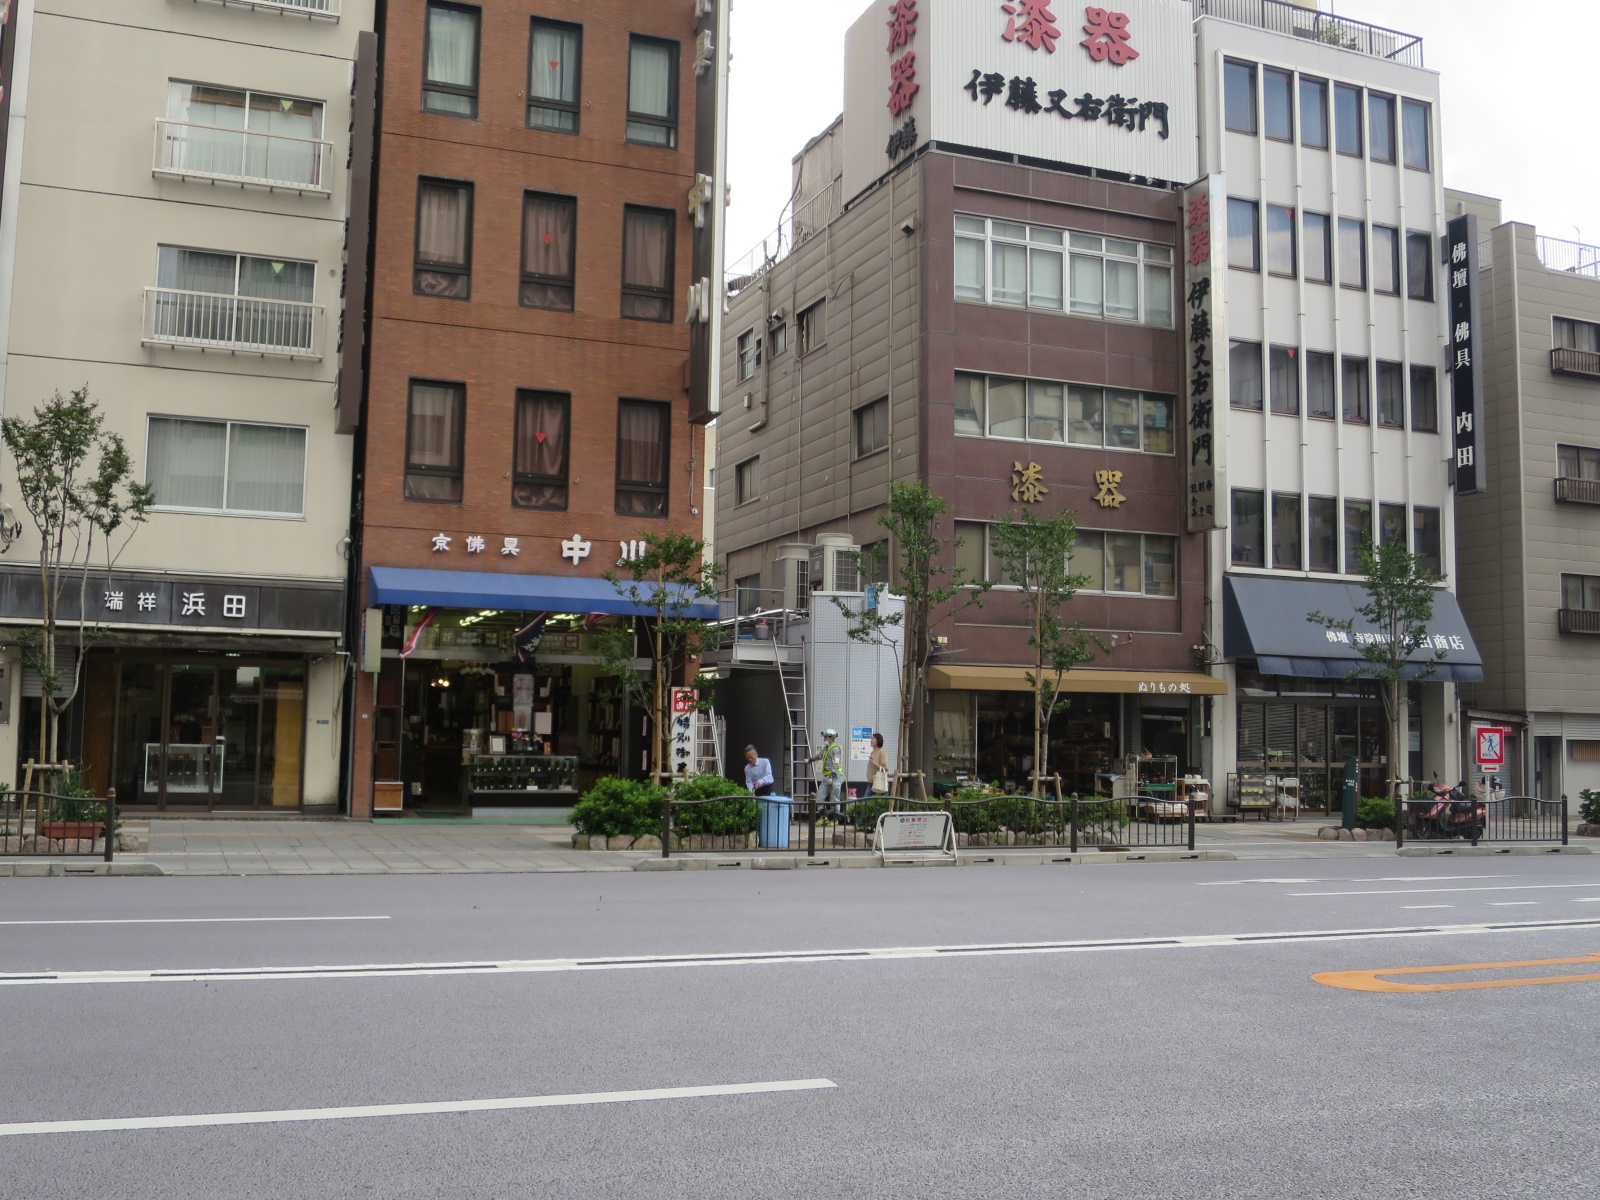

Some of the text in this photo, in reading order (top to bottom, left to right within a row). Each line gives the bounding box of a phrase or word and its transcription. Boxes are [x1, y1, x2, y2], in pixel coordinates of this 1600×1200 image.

[886, 0, 920, 118] 漆器
[1000, 0, 1140, 66] 漆器
[963, 69, 1170, 139] 伊藤又右衛門
[885, 115, 918, 160] 伊藤
[1186, 192, 1213, 467] 漆器 伊藤又右衛門
[1456, 411, 1474, 469] 内田
[1011, 460, 1127, 509] 漆器
[431, 532, 647, 568] 京佛具 中川
[104, 590, 247, 619] 瑞祥 浜田
[1138, 681, 1192, 694] ぬりもの処
